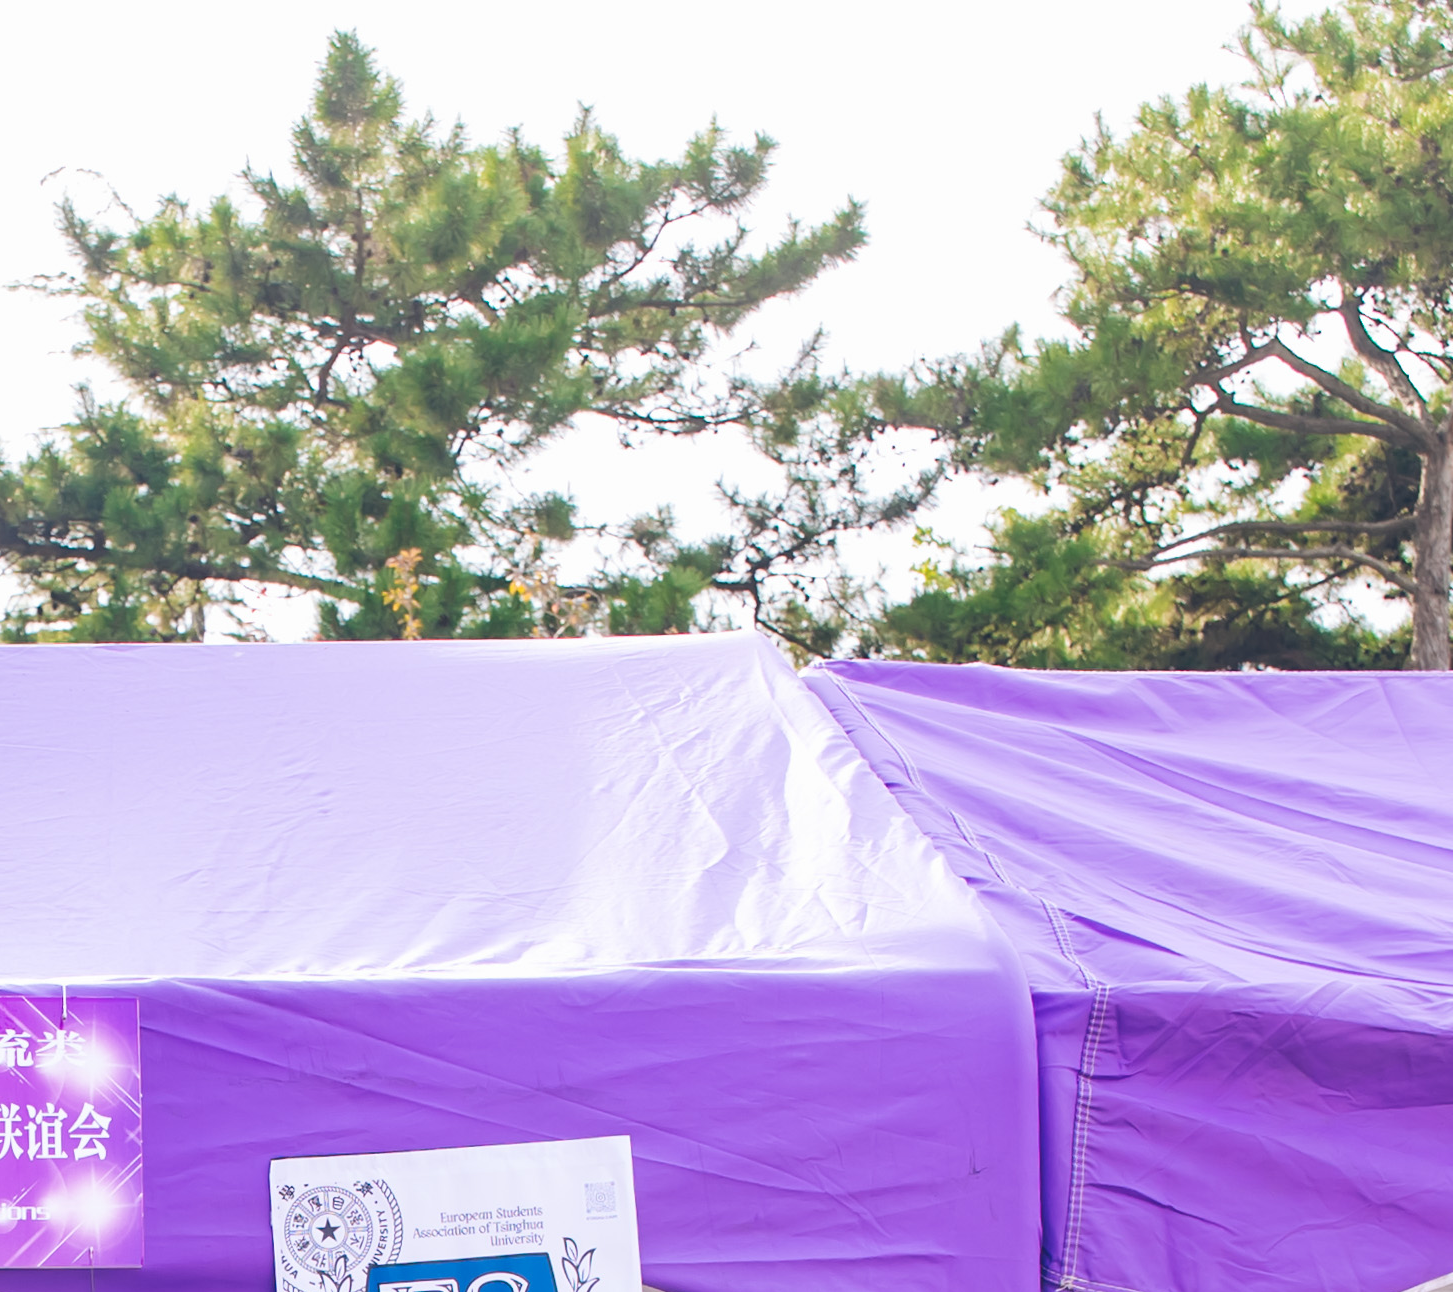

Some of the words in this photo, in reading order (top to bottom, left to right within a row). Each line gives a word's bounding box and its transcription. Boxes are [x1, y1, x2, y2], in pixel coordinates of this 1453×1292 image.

[439, 1210, 493, 1225] European
[496, 1204, 544, 1219] Students
[412, 1222, 476, 1240] Association
[478, 1221, 491, 1235] of
[492, 1219, 545, 1236] Tsinghua
[490, 1232, 545, 1248] University
